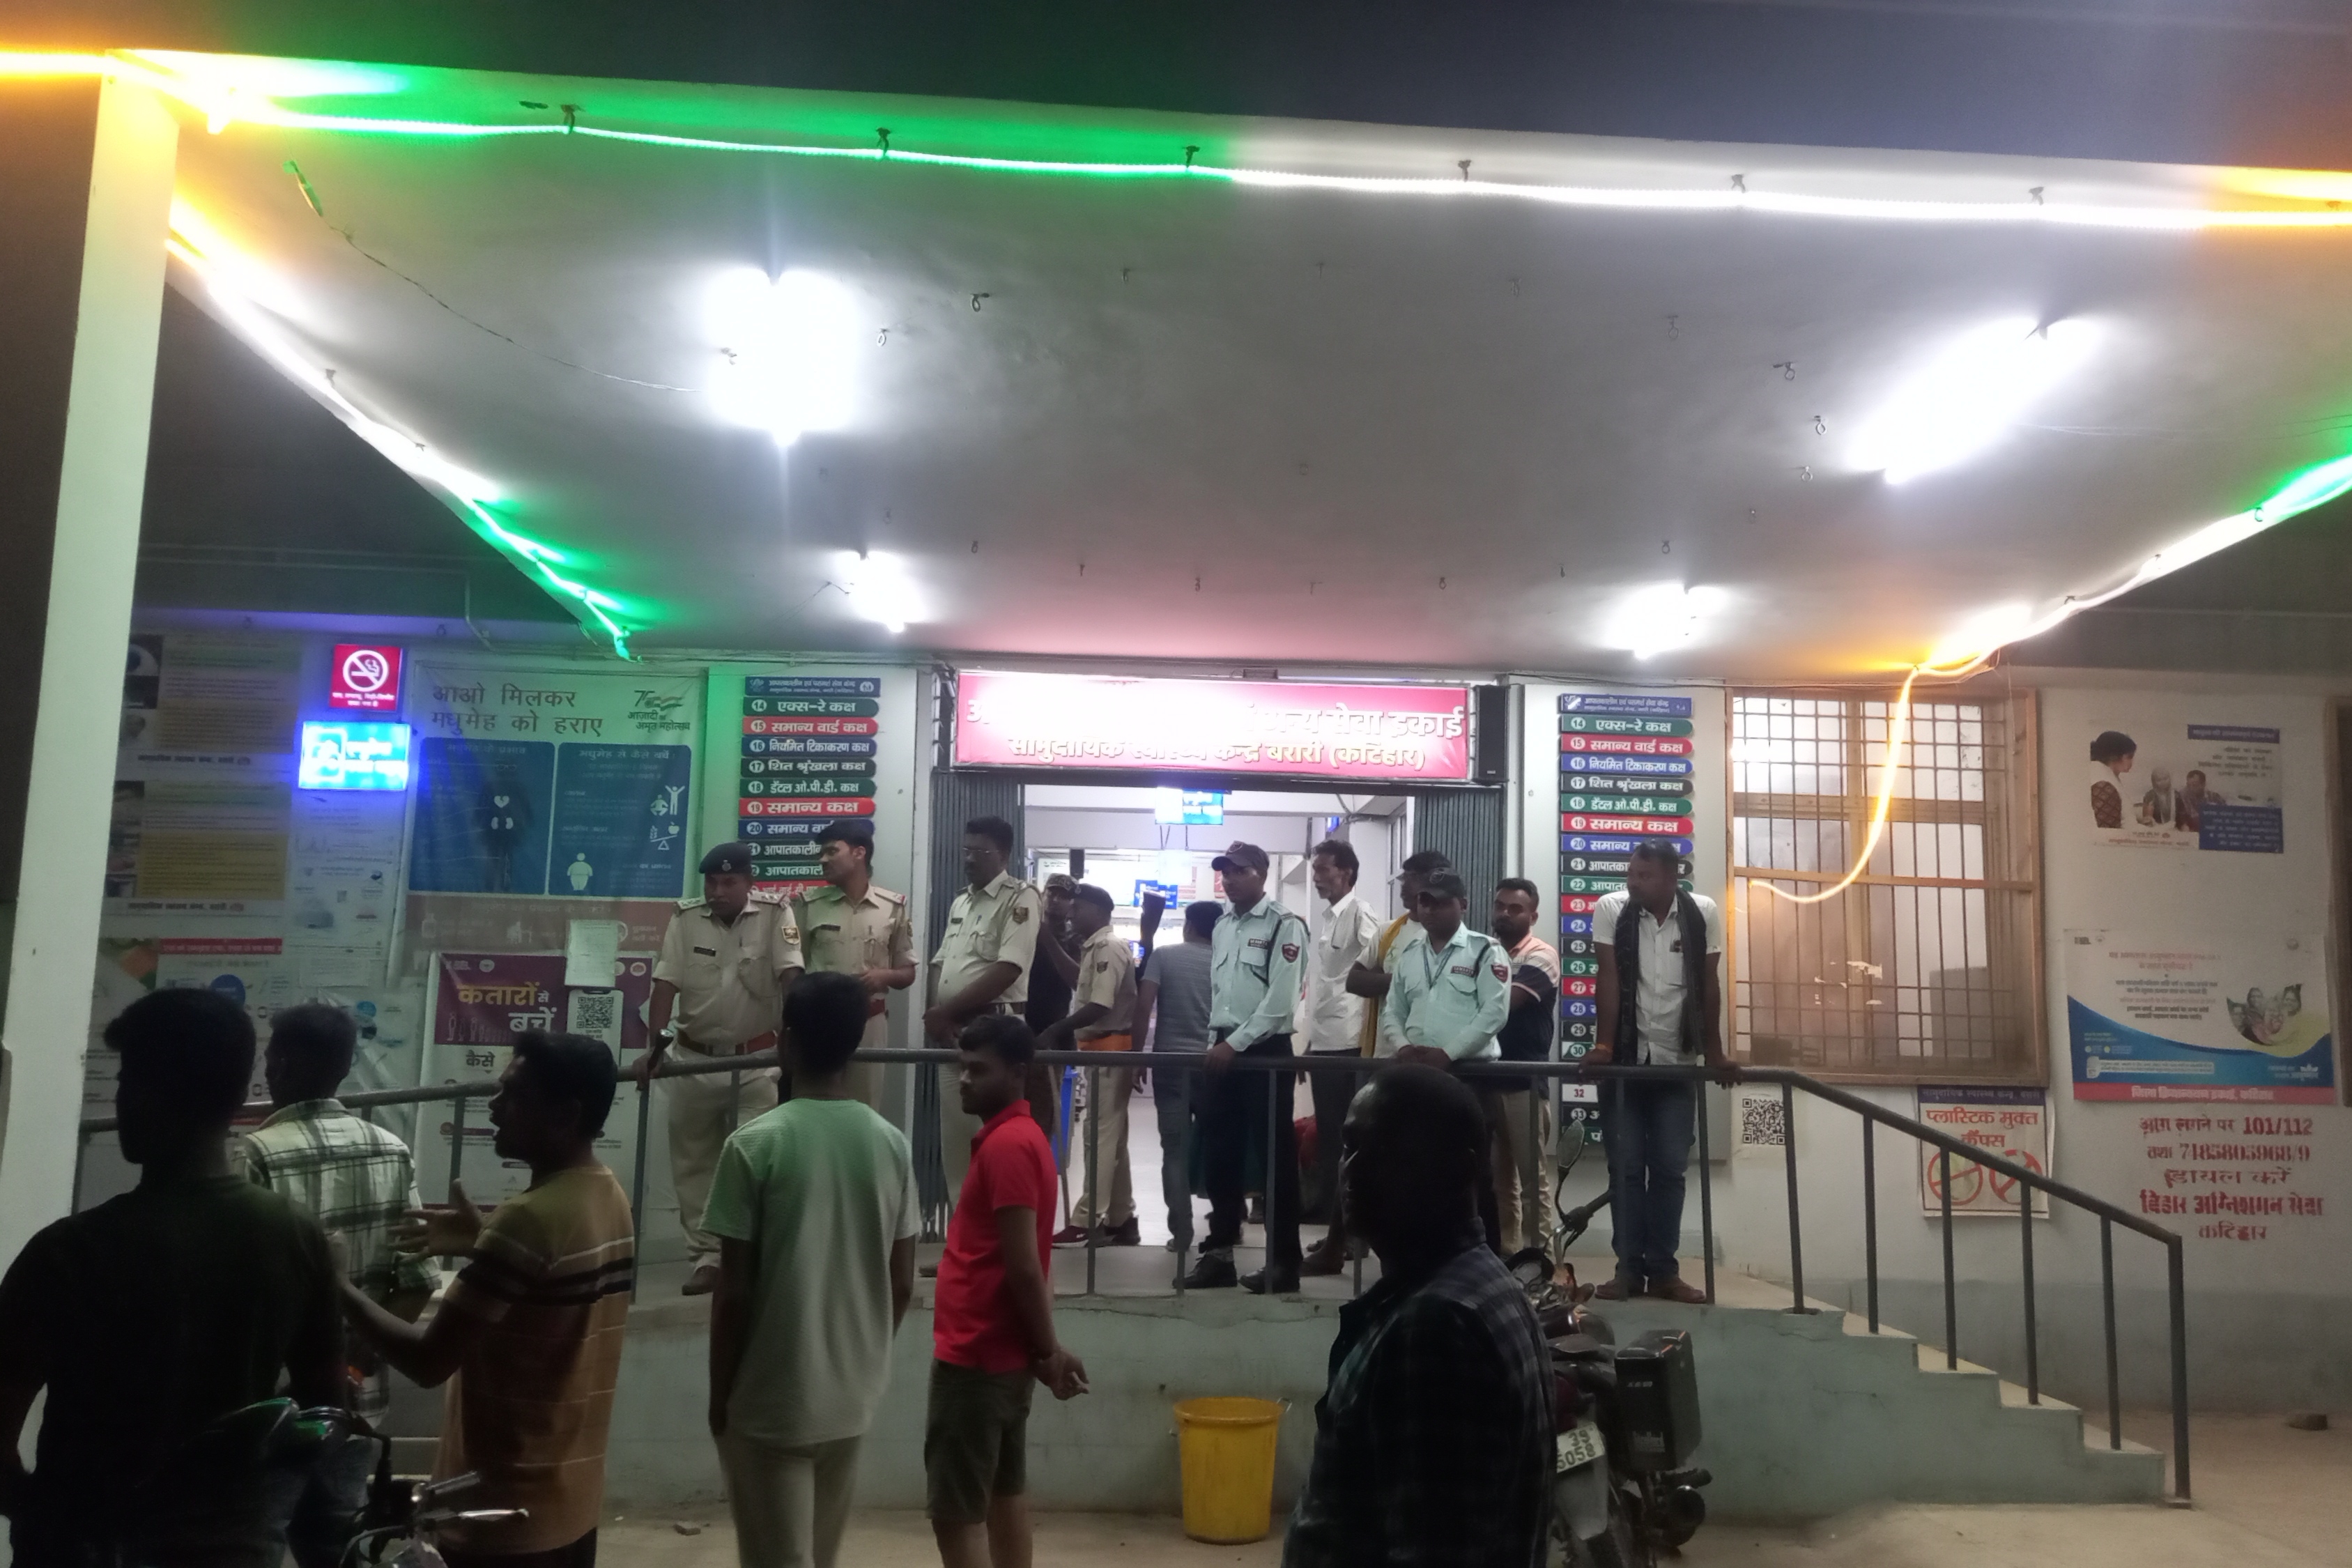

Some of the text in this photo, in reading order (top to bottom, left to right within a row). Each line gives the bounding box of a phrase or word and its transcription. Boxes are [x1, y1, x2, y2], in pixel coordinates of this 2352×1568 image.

[433, 682, 577, 709] आओ मिलकर
[829, 701, 856, 712] कक्ष
[431, 709, 496, 735] मधुमेह
[511, 709, 539, 732] को
[636, 719, 691, 733] अमृत महोत्सव
[817, 720, 840, 733] वार्ड
[843, 723, 868, 733] कक्ष
[1326, 702, 1384, 736] सेवा
[1388, 705, 1465, 739] इकाई
[1646, 722, 1672, 732] कक्ष
[769, 739, 804, 752] नियमित
[852, 743, 870, 753] कक्ष
[1634, 739, 1657, 753] वार्ड
[1659, 742, 1683, 753] कक्ष
[841, 761, 866, 771] कक्ष
[1589, 758, 1622, 770] नियमित
[1669, 762, 1686, 773] कक्ष
[840, 783, 859, 792] कक्ष
[1659, 781, 1683, 791] कक्ष
[827, 802, 859, 813] कक्ष
[1659, 803, 1677, 813] कक्ष
[1647, 820, 1678, 833] कक्ष
[456, 981, 550, 1006] कतारों से
[508, 1006, 557, 1033] बचें
[466, 1050, 495, 1068] कैसे
[1573, 1088, 1585, 1098] 32
[1926, 1106, 2038, 1130] प्लास्टिक मुक्त
[2140, 1114, 2314, 1136] आग लगने पर 101/112
[2147, 1146, 2173, 1160] तथा
[2248, 1165, 2292, 1185] करें
[2139, 1189, 2324, 1216] बिहार अग्निशमन सेवा
[2198, 1220, 2268, 1240] कटिहार
[1568, 1429, 1591, 1447] 39
